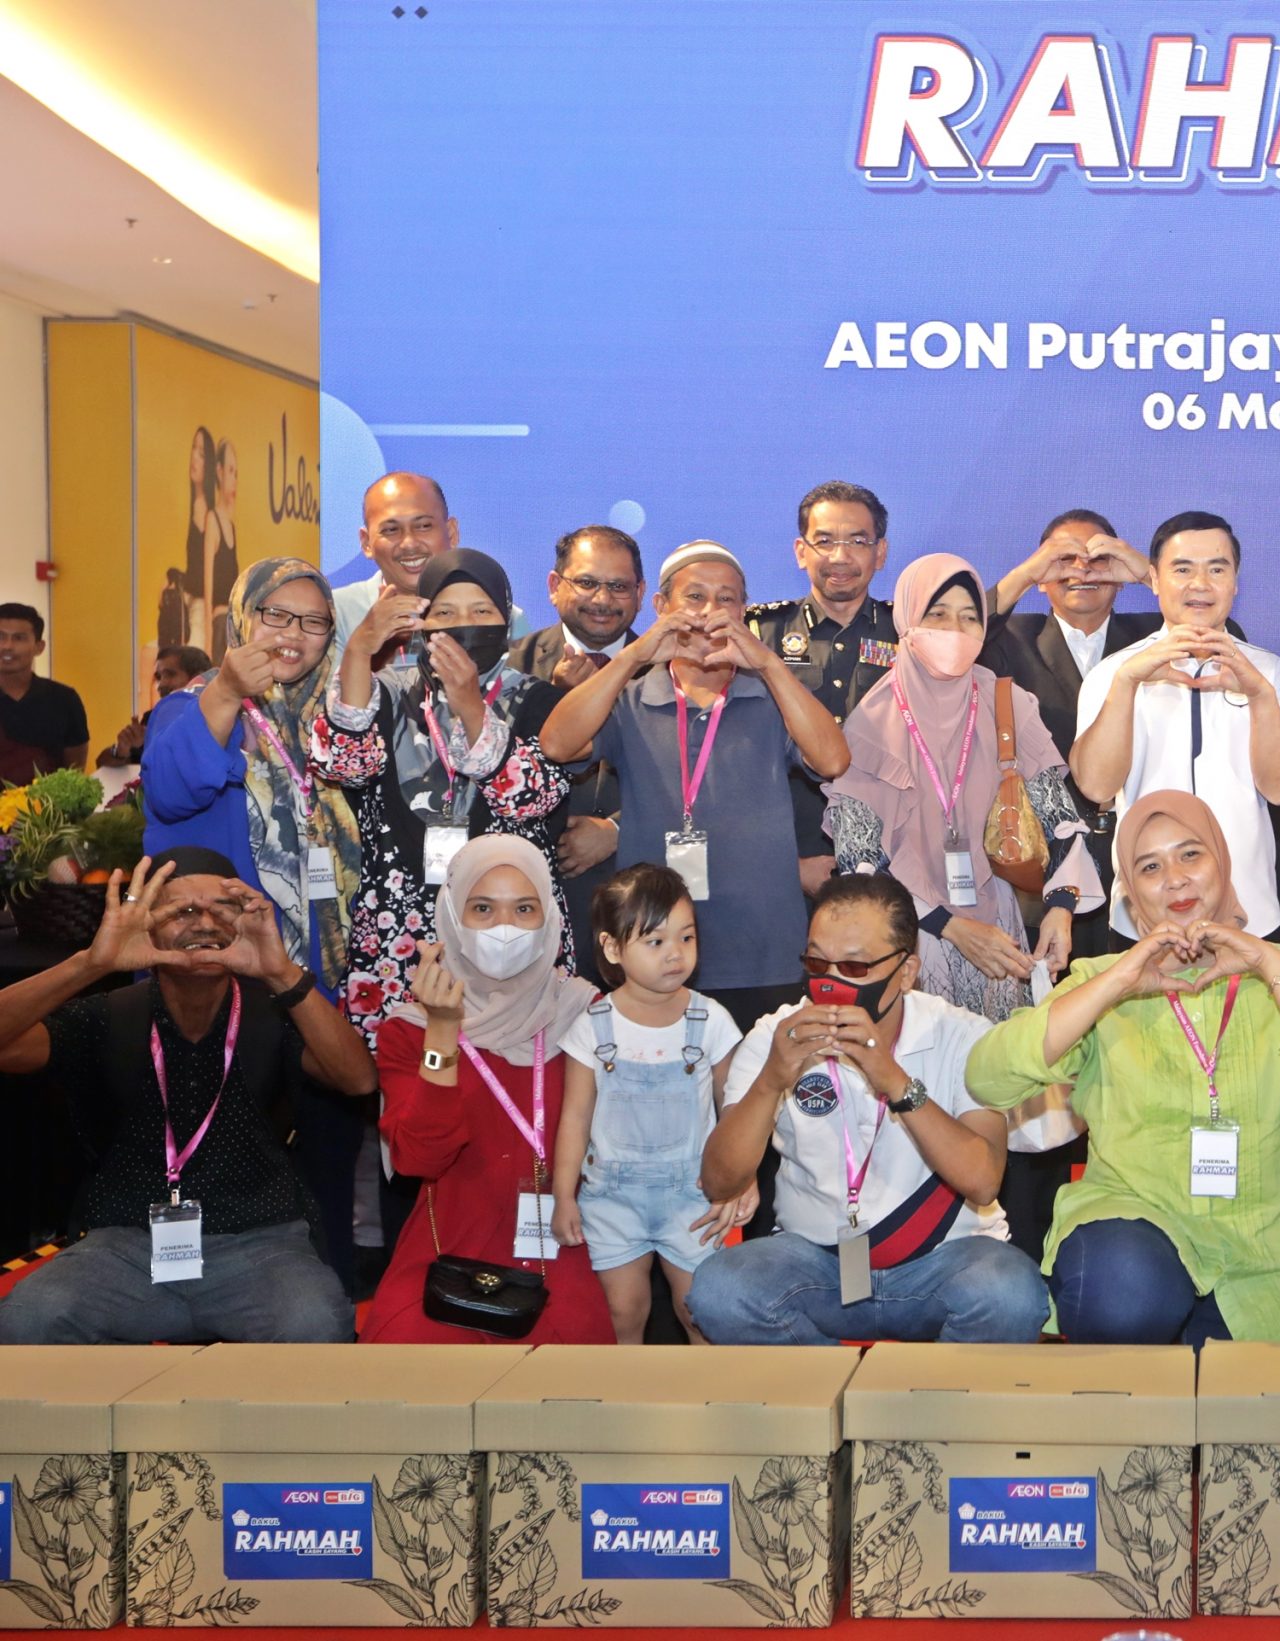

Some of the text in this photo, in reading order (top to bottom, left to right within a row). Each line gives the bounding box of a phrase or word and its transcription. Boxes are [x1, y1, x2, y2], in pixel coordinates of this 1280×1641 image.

[824, 321, 1008, 369] AEON
[1142, 392, 1206, 430] 06
[807, 1099, 826, 1108] USPA
[340, 1490, 360, 1500] BIG
[235, 1530, 361, 1552] RAHMAH
[594, 1530, 719, 1552] RAHMAH
[961, 1524, 1084, 1545] RAHMAH
